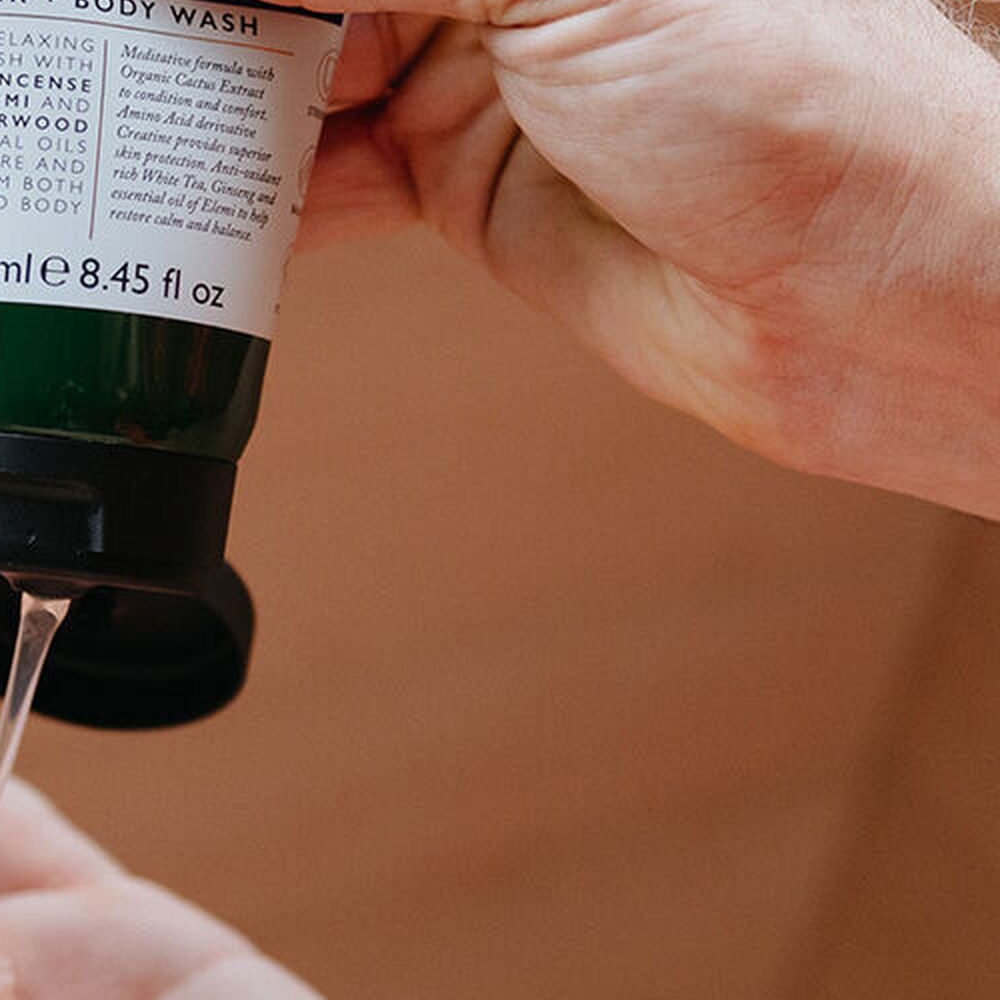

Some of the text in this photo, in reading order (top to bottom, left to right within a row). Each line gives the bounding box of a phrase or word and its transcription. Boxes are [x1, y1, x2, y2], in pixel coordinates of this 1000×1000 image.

[170, 5, 258, 35] WASH
[34, 54, 93, 72] WITH
[120, 44, 275, 81] Meditative formula with
[120, 64, 265, 99] Organic Cactus Extract
[41, 96, 91, 113] AND
[119, 87, 130, 99] to
[134, 88, 193, 107] condition
[195, 98, 219, 111] and
[117, 105, 257, 139] Amino Acid derivative
[37, 136, 87, 153] OILS
[115, 145, 141, 160] skin
[117, 124, 273, 162] Creatine provides superior
[35, 157, 85, 174] AND
[24, 176, 83, 194] BOTH
[113, 166, 277, 205] rich White Tea, Ginseng and
[21, 197, 82, 214] BODY
[111, 188, 166, 205] essential
[168, 194, 186, 207] oil
[187, 197, 200, 214] of
[201, 199, 235, 217] Elemi
[237, 208, 248, 221] to
[109, 208, 151, 223] restore
[154, 213, 183, 229] calm
[186, 219, 210, 233] and
[79, 258, 150, 295] 8.45
[162, 268, 182, 300] fl
[192, 283, 225, 308] oz
